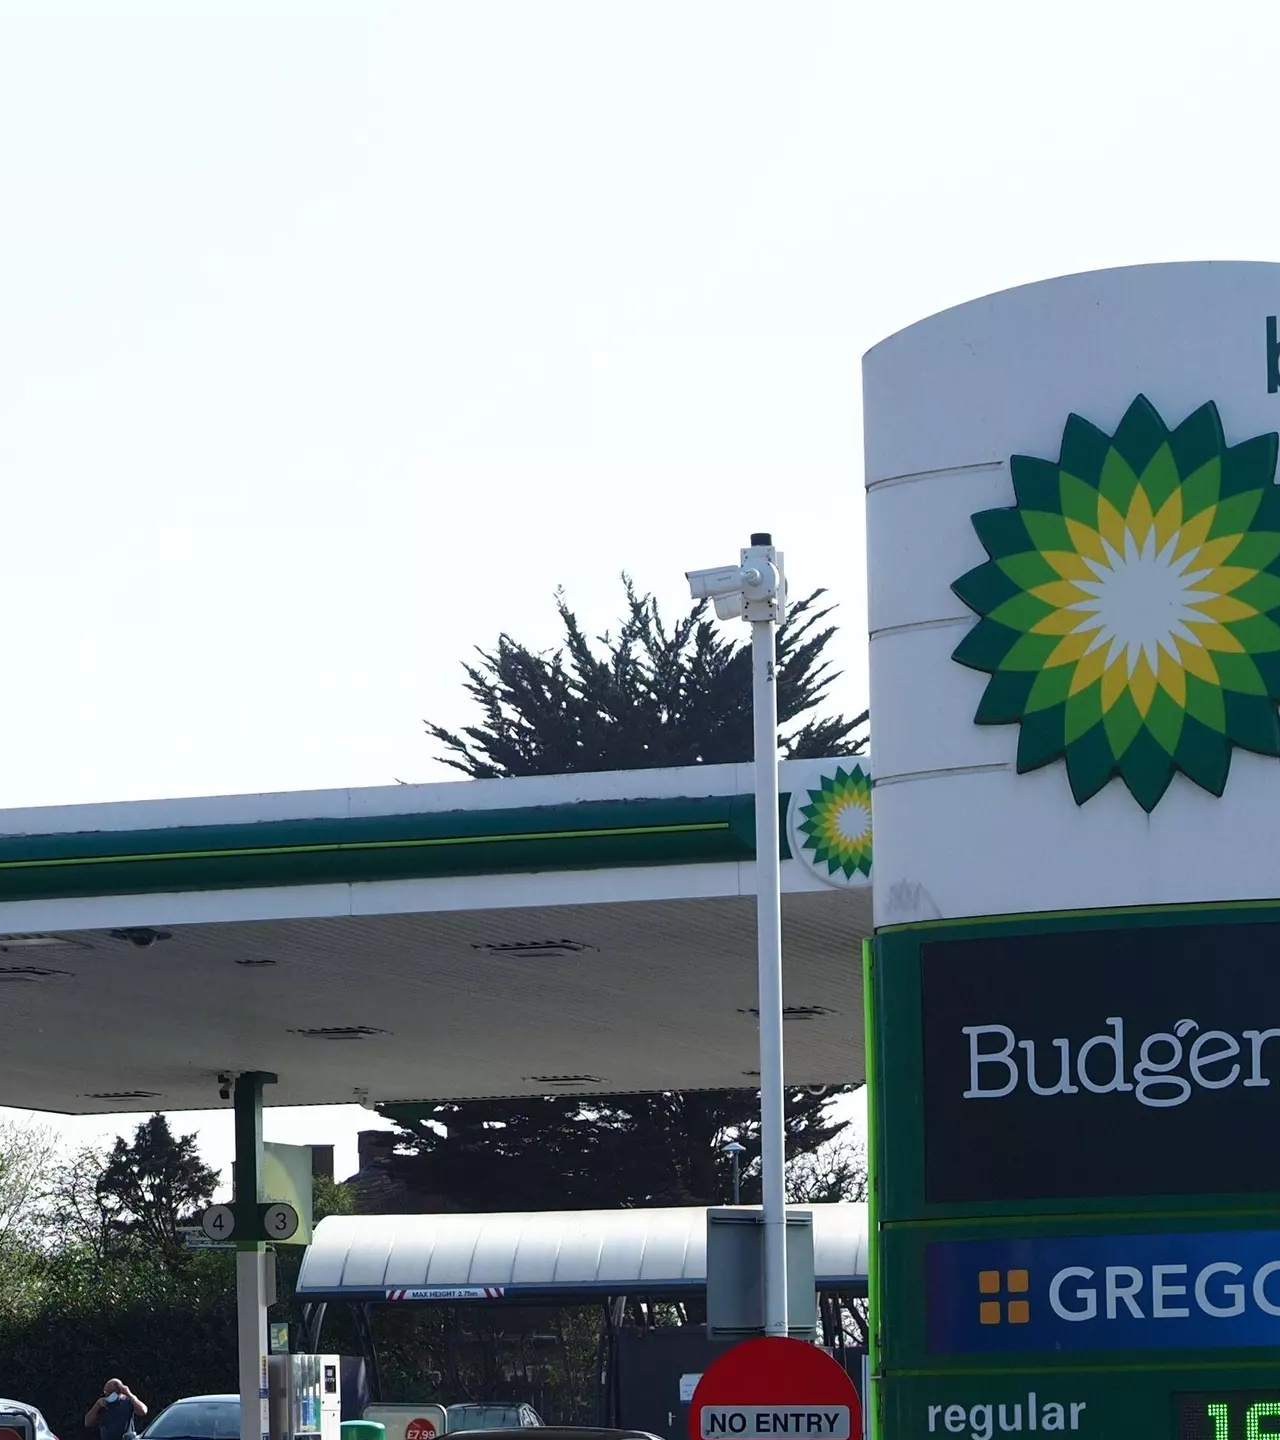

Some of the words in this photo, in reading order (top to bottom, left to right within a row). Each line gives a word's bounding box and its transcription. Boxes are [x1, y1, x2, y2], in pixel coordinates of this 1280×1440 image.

[212, 1213, 225, 1231] 4
[275, 1212, 287, 1230] 3
[429, 1290, 456, 1298] HEIGHT
[709, 1412, 747, 1433] NO
[755, 1413, 840, 1433] ENTRY
[407, 1430, 435, 1440] £7.99
